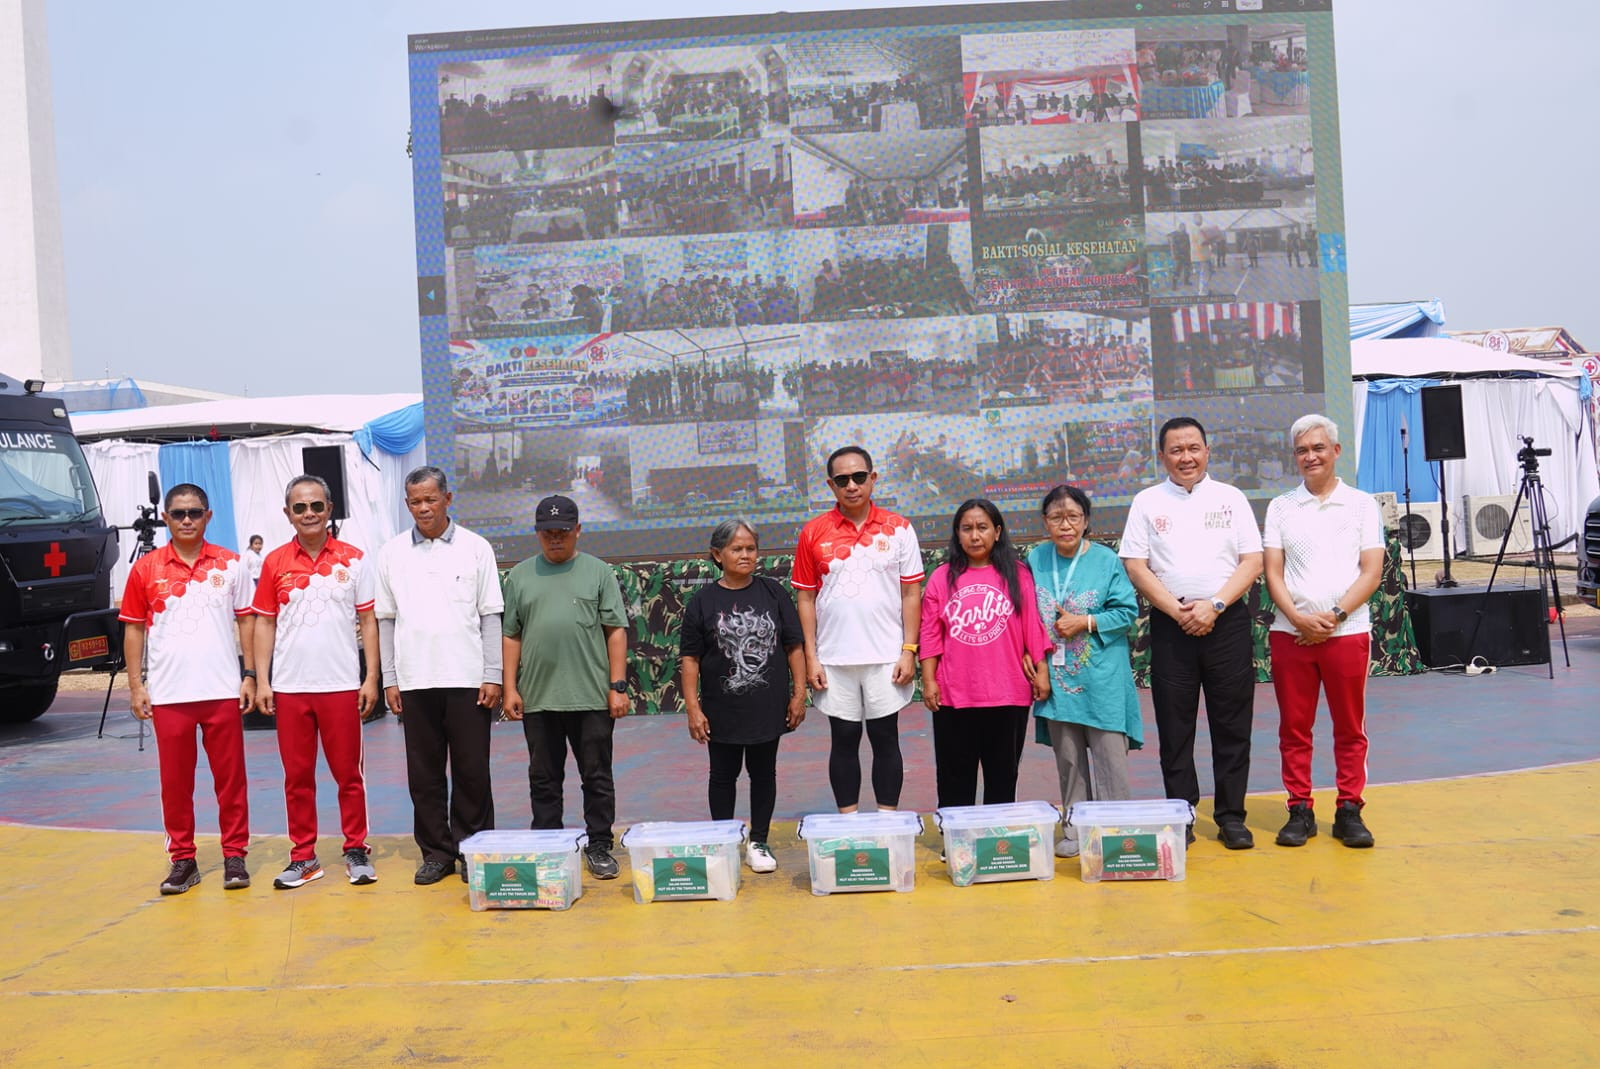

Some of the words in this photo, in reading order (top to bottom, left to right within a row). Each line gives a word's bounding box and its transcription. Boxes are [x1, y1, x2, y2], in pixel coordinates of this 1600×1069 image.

[982, 245, 1019, 259] BAKTI
[1021, 243, 1063, 257] SOSIAL
[1066, 239, 1137, 254] KESEHATAN
[486, 361, 522, 377] BAKTI
[523, 359, 589, 373] KESEHATAN
[943, 591, 1014, 637] Barbie
